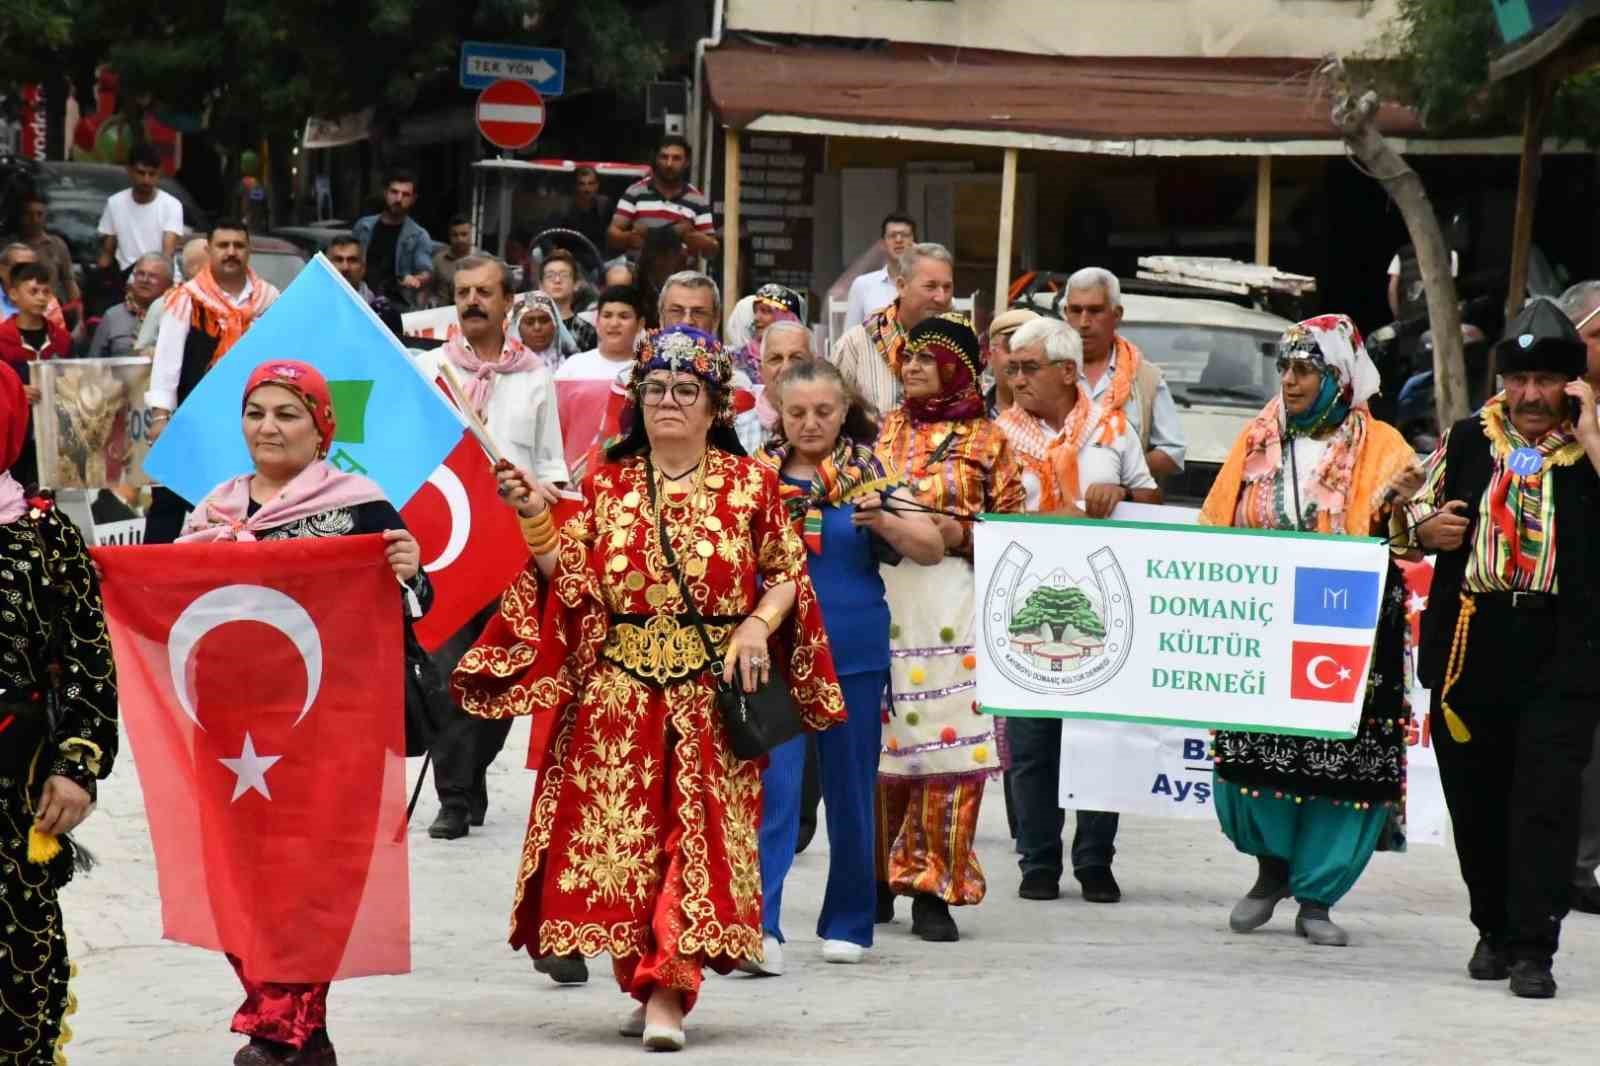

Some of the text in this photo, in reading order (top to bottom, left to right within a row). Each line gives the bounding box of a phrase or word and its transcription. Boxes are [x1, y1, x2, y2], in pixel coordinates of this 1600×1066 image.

[473, 59, 499, 73] TEK
[1145, 558, 1281, 586] KAYIBOYU
[1149, 594, 1274, 627] DOMANİÇ
[1158, 628, 1262, 659] KÜLTÜR
[1151, 667, 1266, 696] DERNEĞİ
[1183, 738, 1213, 761] B
